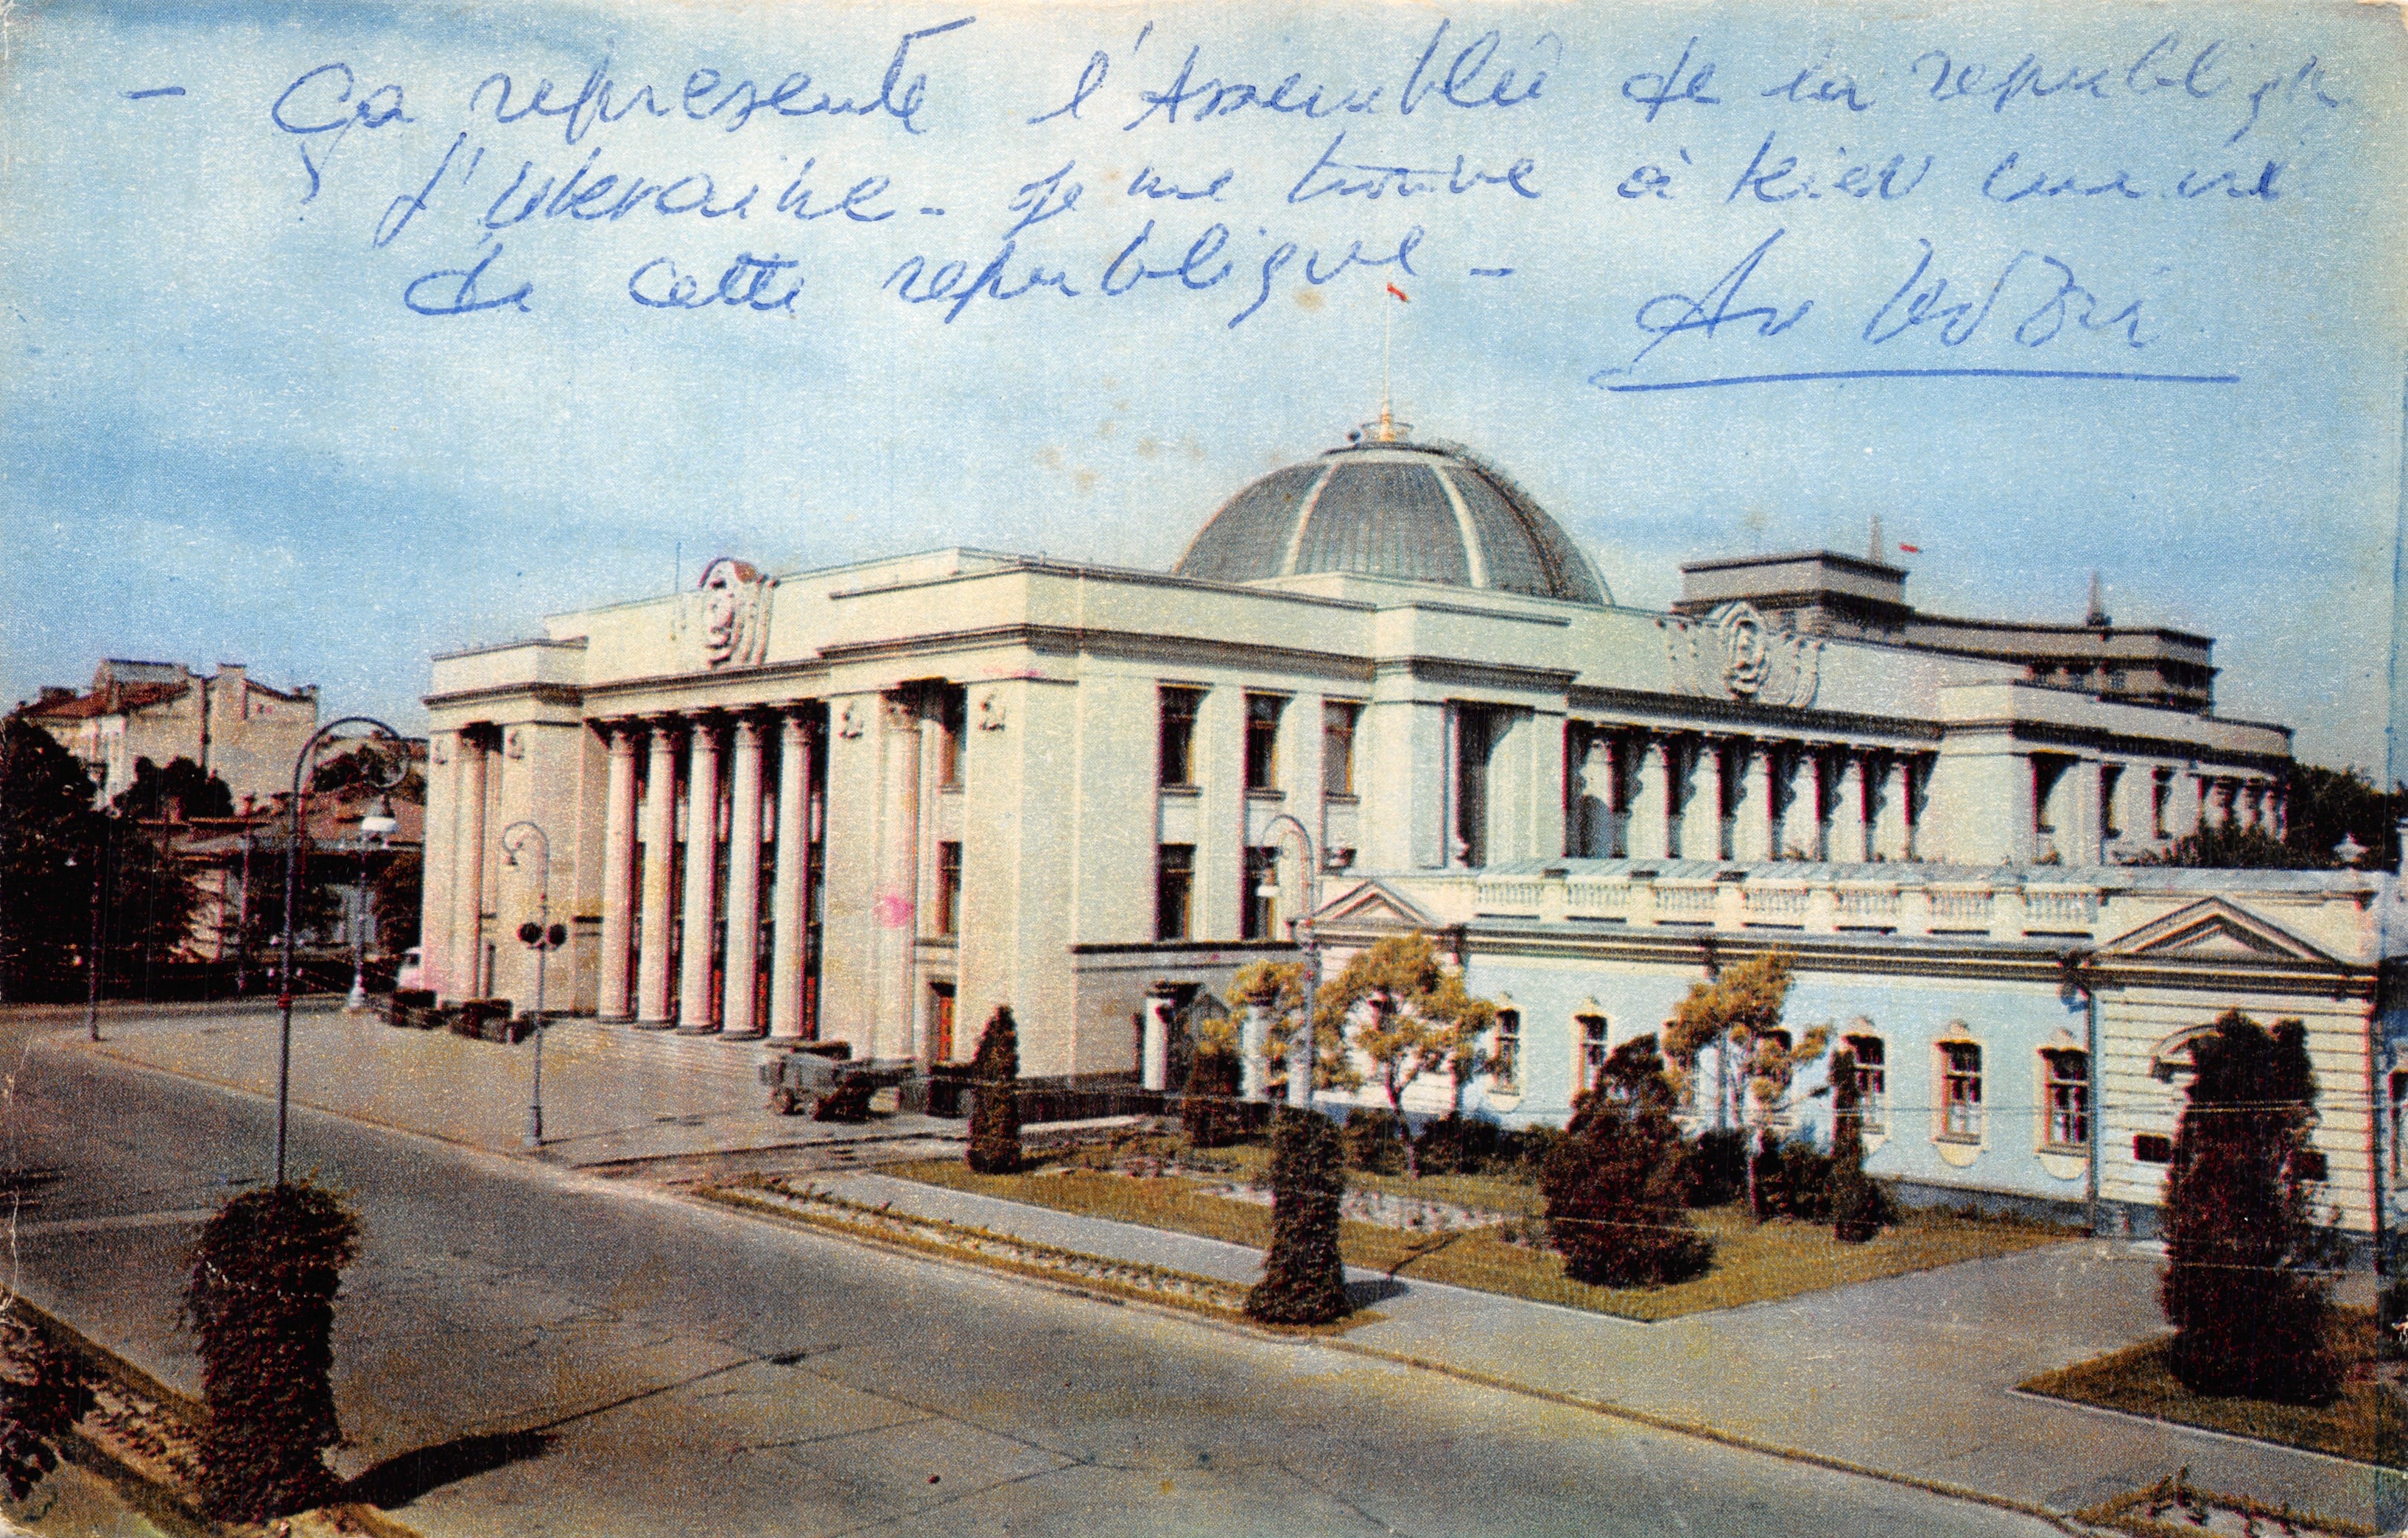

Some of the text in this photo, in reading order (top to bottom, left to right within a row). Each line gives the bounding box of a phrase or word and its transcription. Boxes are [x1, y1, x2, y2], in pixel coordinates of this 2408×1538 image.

[1621, 37, 1721, 122] de
[1762, 52, 1874, 110] la
[1127, 165, 1235, 200] me
[1288, 130, 1544, 203] trouve
